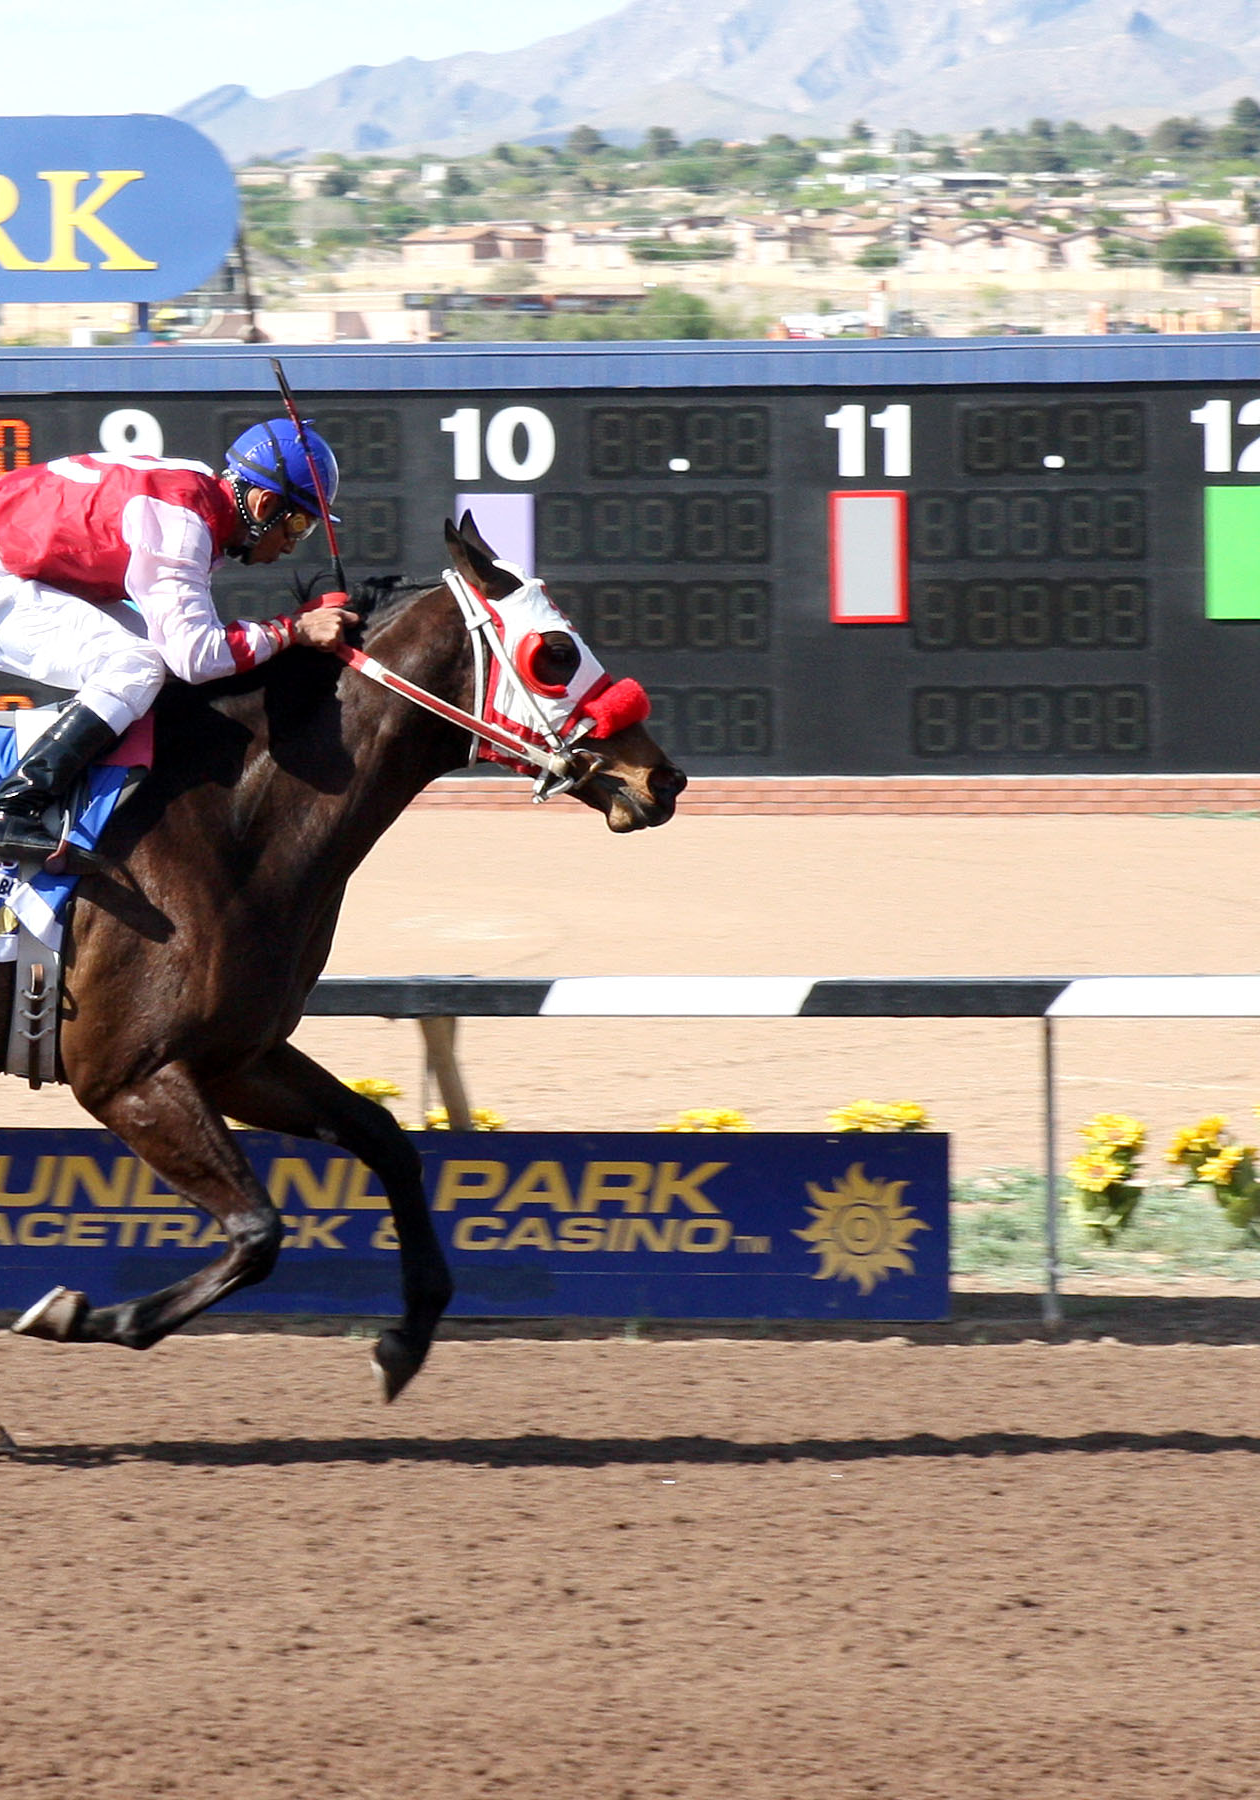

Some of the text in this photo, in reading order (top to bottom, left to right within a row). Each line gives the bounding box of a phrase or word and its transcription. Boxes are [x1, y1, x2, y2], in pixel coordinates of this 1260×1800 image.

[440, 406, 555, 481] 10
[825, 404, 911, 477] 11
[432, 1159, 731, 1214] PARK
[451, 1216, 734, 1254] CASINO
